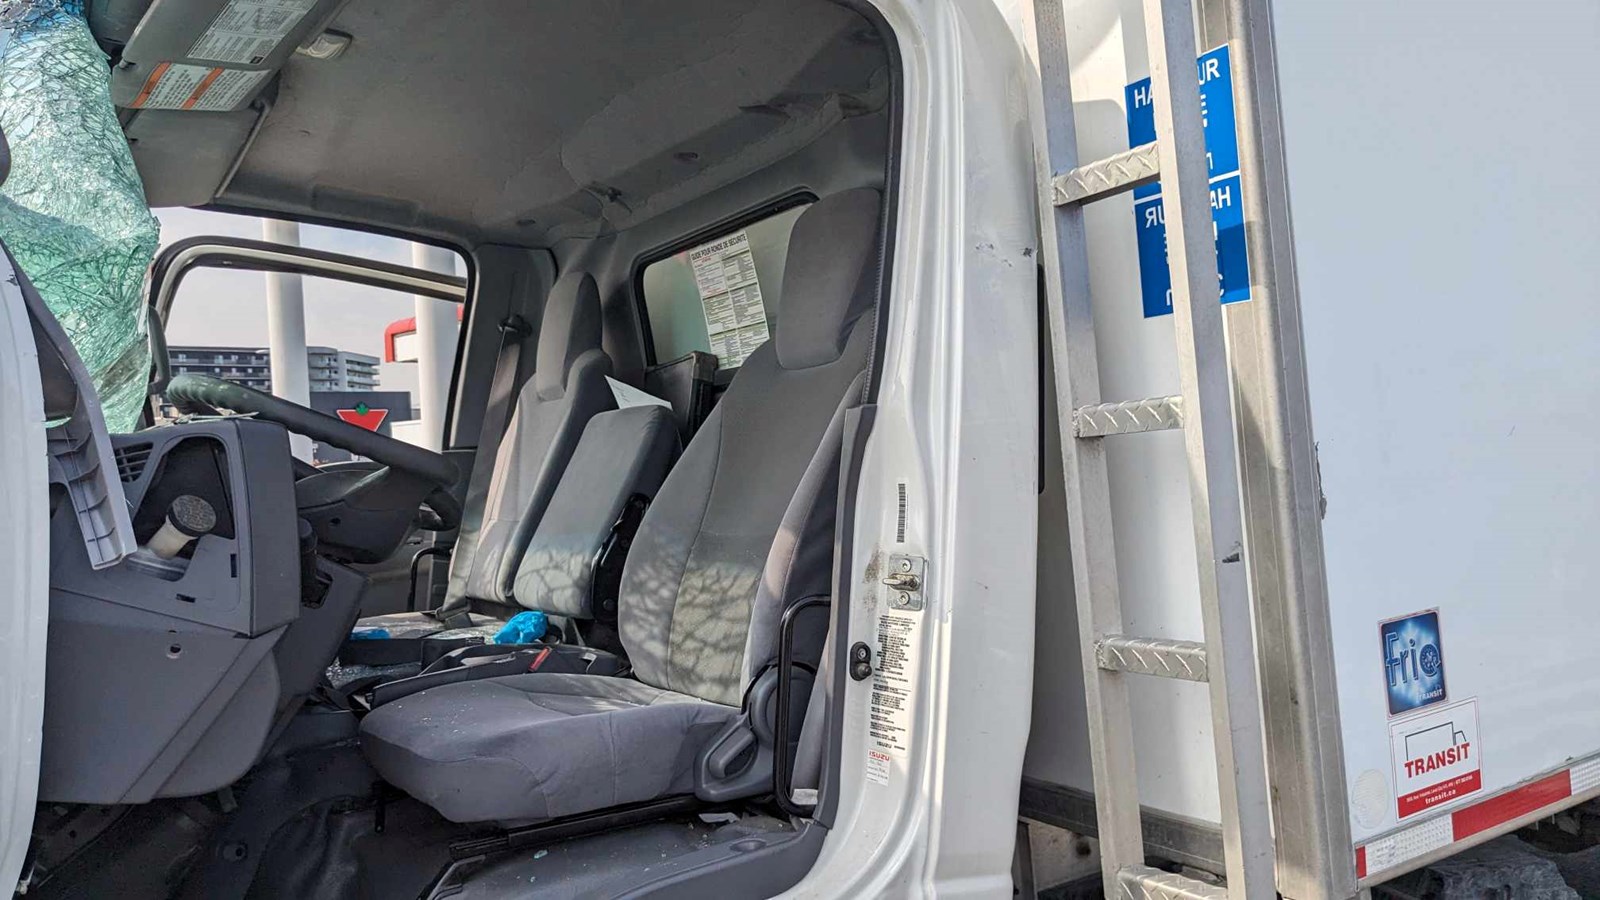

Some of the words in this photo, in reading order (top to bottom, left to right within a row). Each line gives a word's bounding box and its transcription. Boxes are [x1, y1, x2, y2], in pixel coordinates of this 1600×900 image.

[868, 751, 890, 762] ISUZU
[1404, 743, 1470, 779] TRANSIT
[1425, 789, 1456, 804] transit.ca
